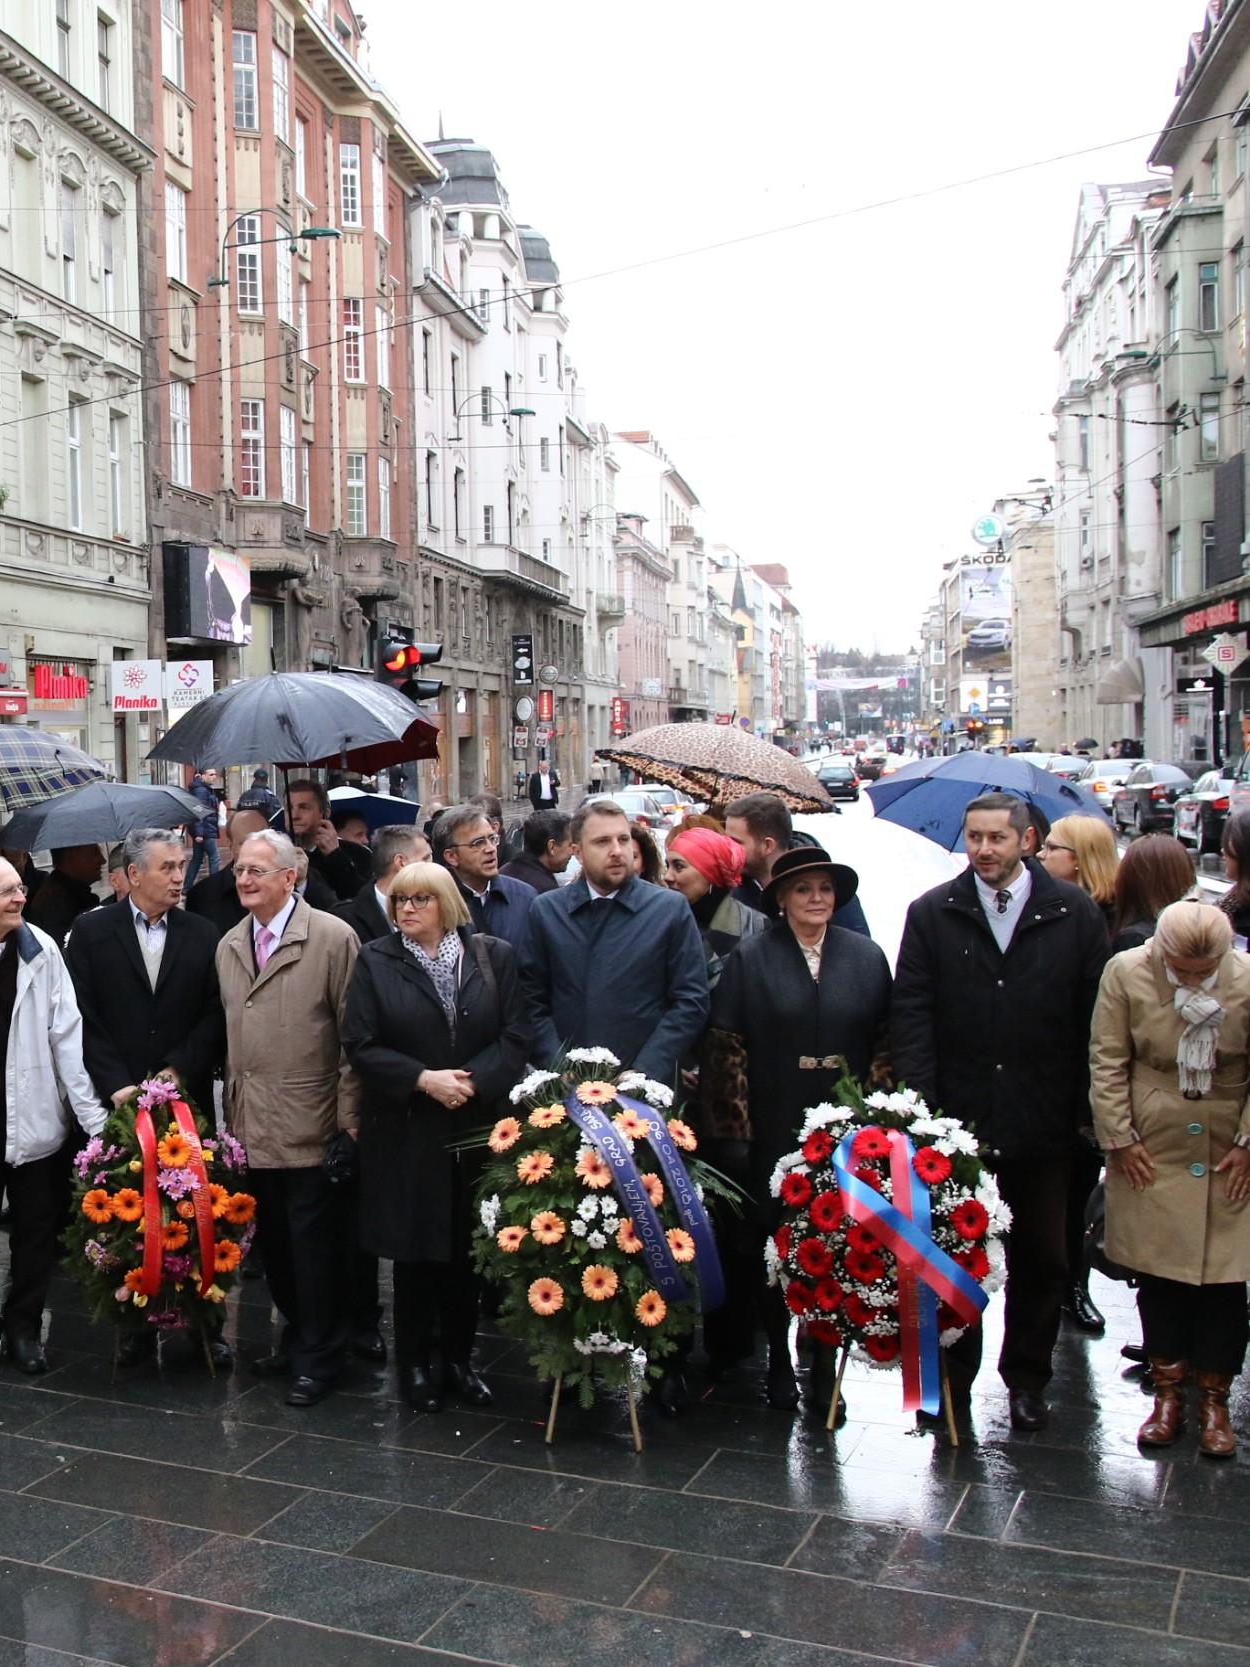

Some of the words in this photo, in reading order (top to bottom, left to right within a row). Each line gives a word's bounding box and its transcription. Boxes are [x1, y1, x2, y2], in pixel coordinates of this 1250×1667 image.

[35, 664, 87, 699] Planika
[114, 694, 158, 709] Planika
[602, 1136, 627, 1167] GRAD
